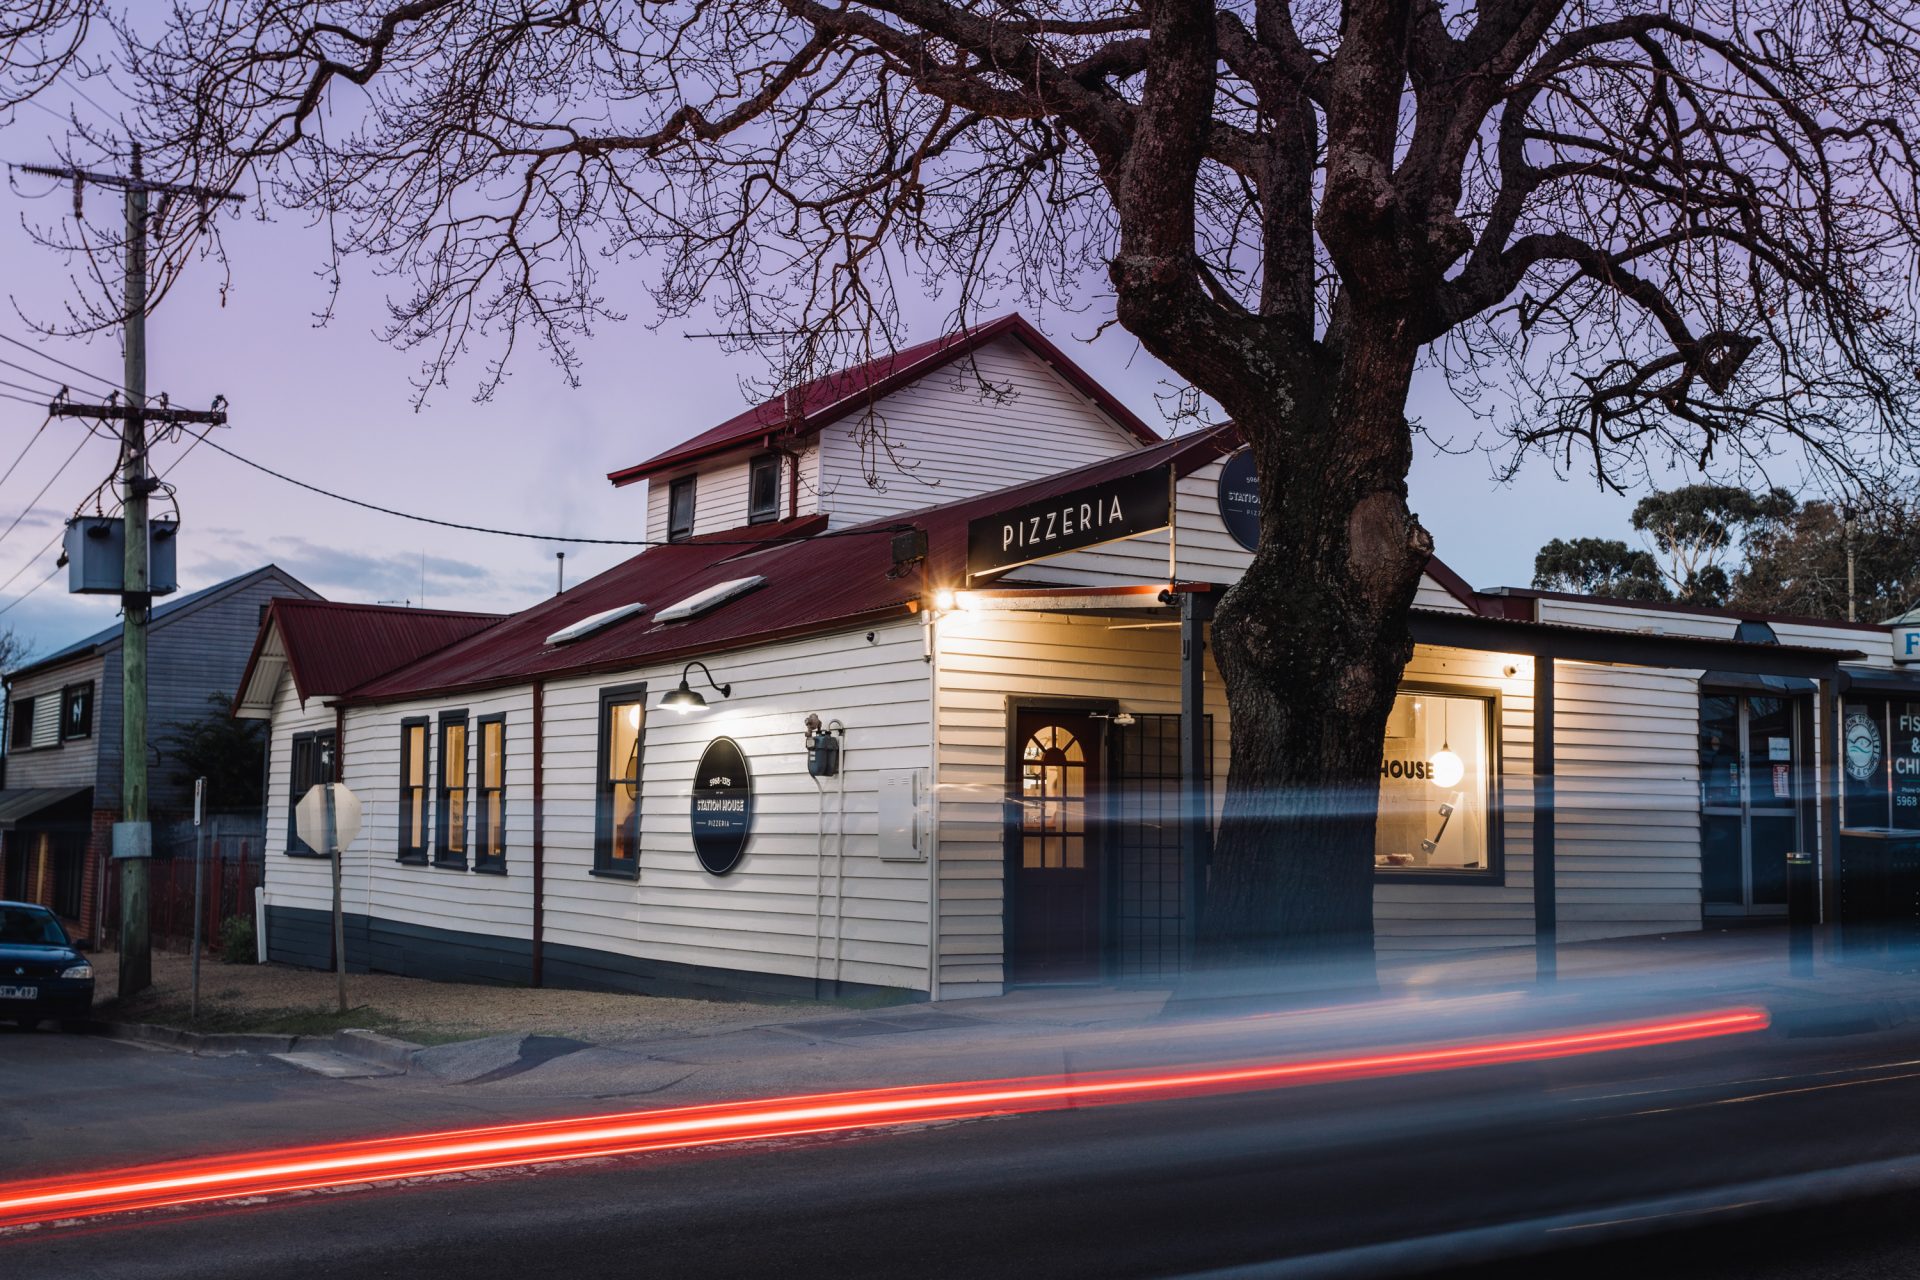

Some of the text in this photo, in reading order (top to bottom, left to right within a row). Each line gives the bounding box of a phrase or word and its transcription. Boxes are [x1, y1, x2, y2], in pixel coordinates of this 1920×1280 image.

[1003, 495, 1123, 552] PIZZERIA
[1895, 757, 1920, 775] CHI
[697, 799, 745, 812] STATION HOUSE
[1896, 795, 1917, 806] 5968
